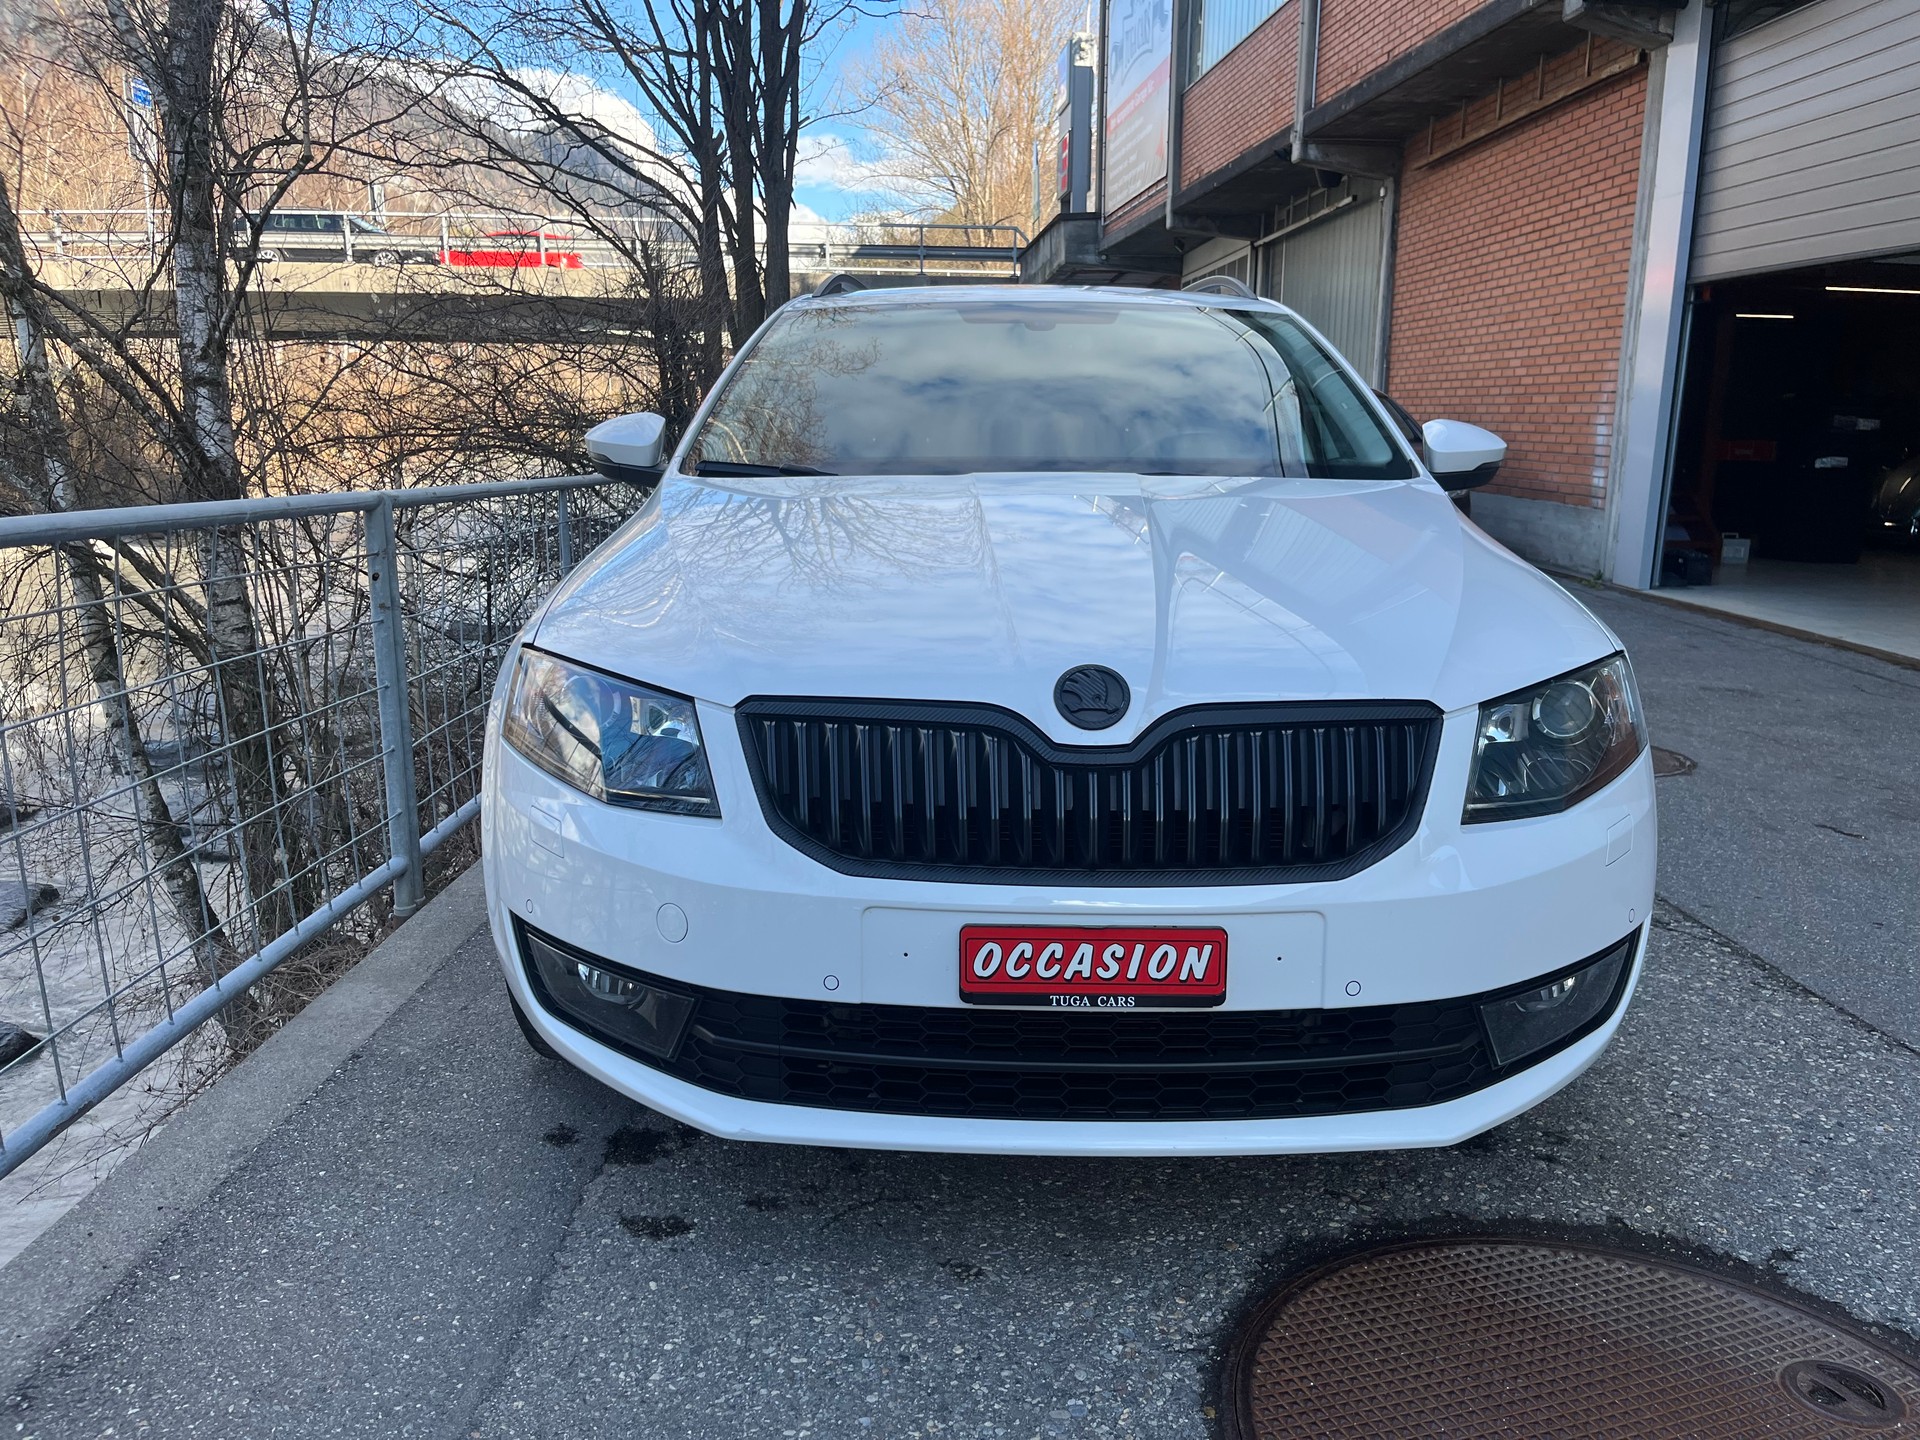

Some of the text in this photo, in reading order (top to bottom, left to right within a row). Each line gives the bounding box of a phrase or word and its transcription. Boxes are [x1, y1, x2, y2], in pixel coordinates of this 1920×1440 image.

[973, 941, 1213, 982] OCCASION
[1050, 995, 1136, 1008] TUGA CARS
